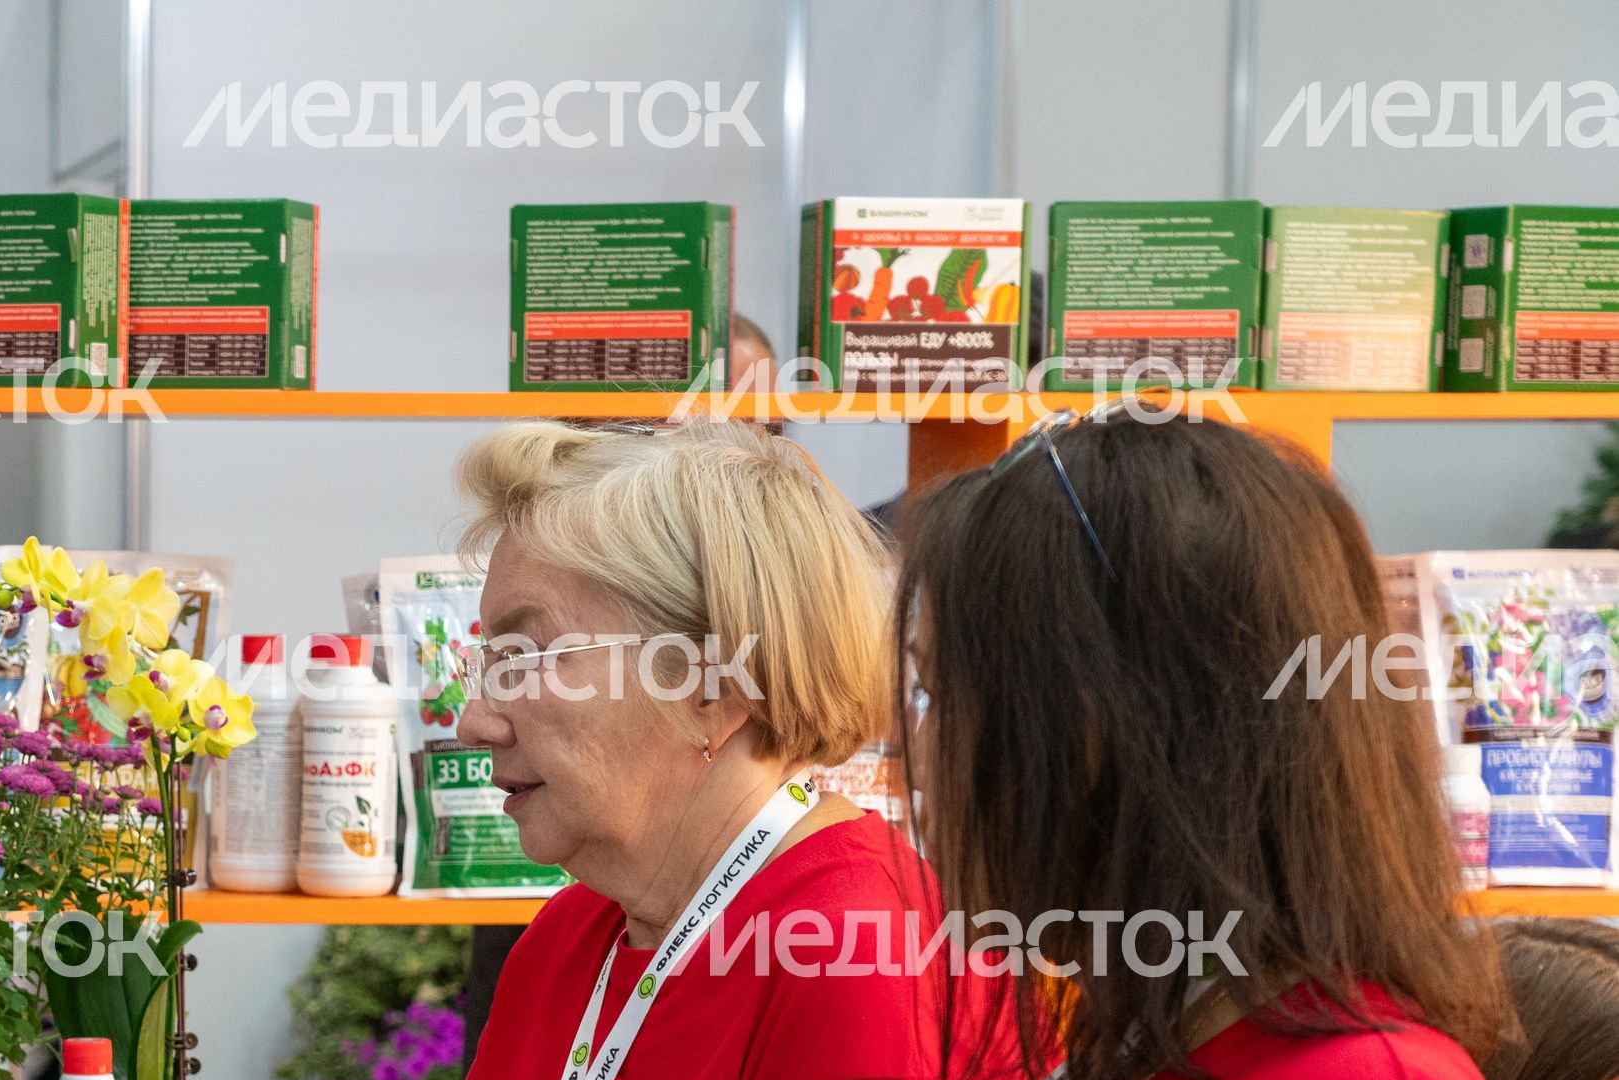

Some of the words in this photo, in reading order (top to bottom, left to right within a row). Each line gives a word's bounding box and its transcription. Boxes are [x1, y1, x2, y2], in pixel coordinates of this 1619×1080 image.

[845, 331, 918, 351] Выращивай
[920, 332, 946, 350] ЕДУ
[655, 914, 702, 973] ФЛЕКС
[698, 828, 772, 919] ЛОГИСТИКА
